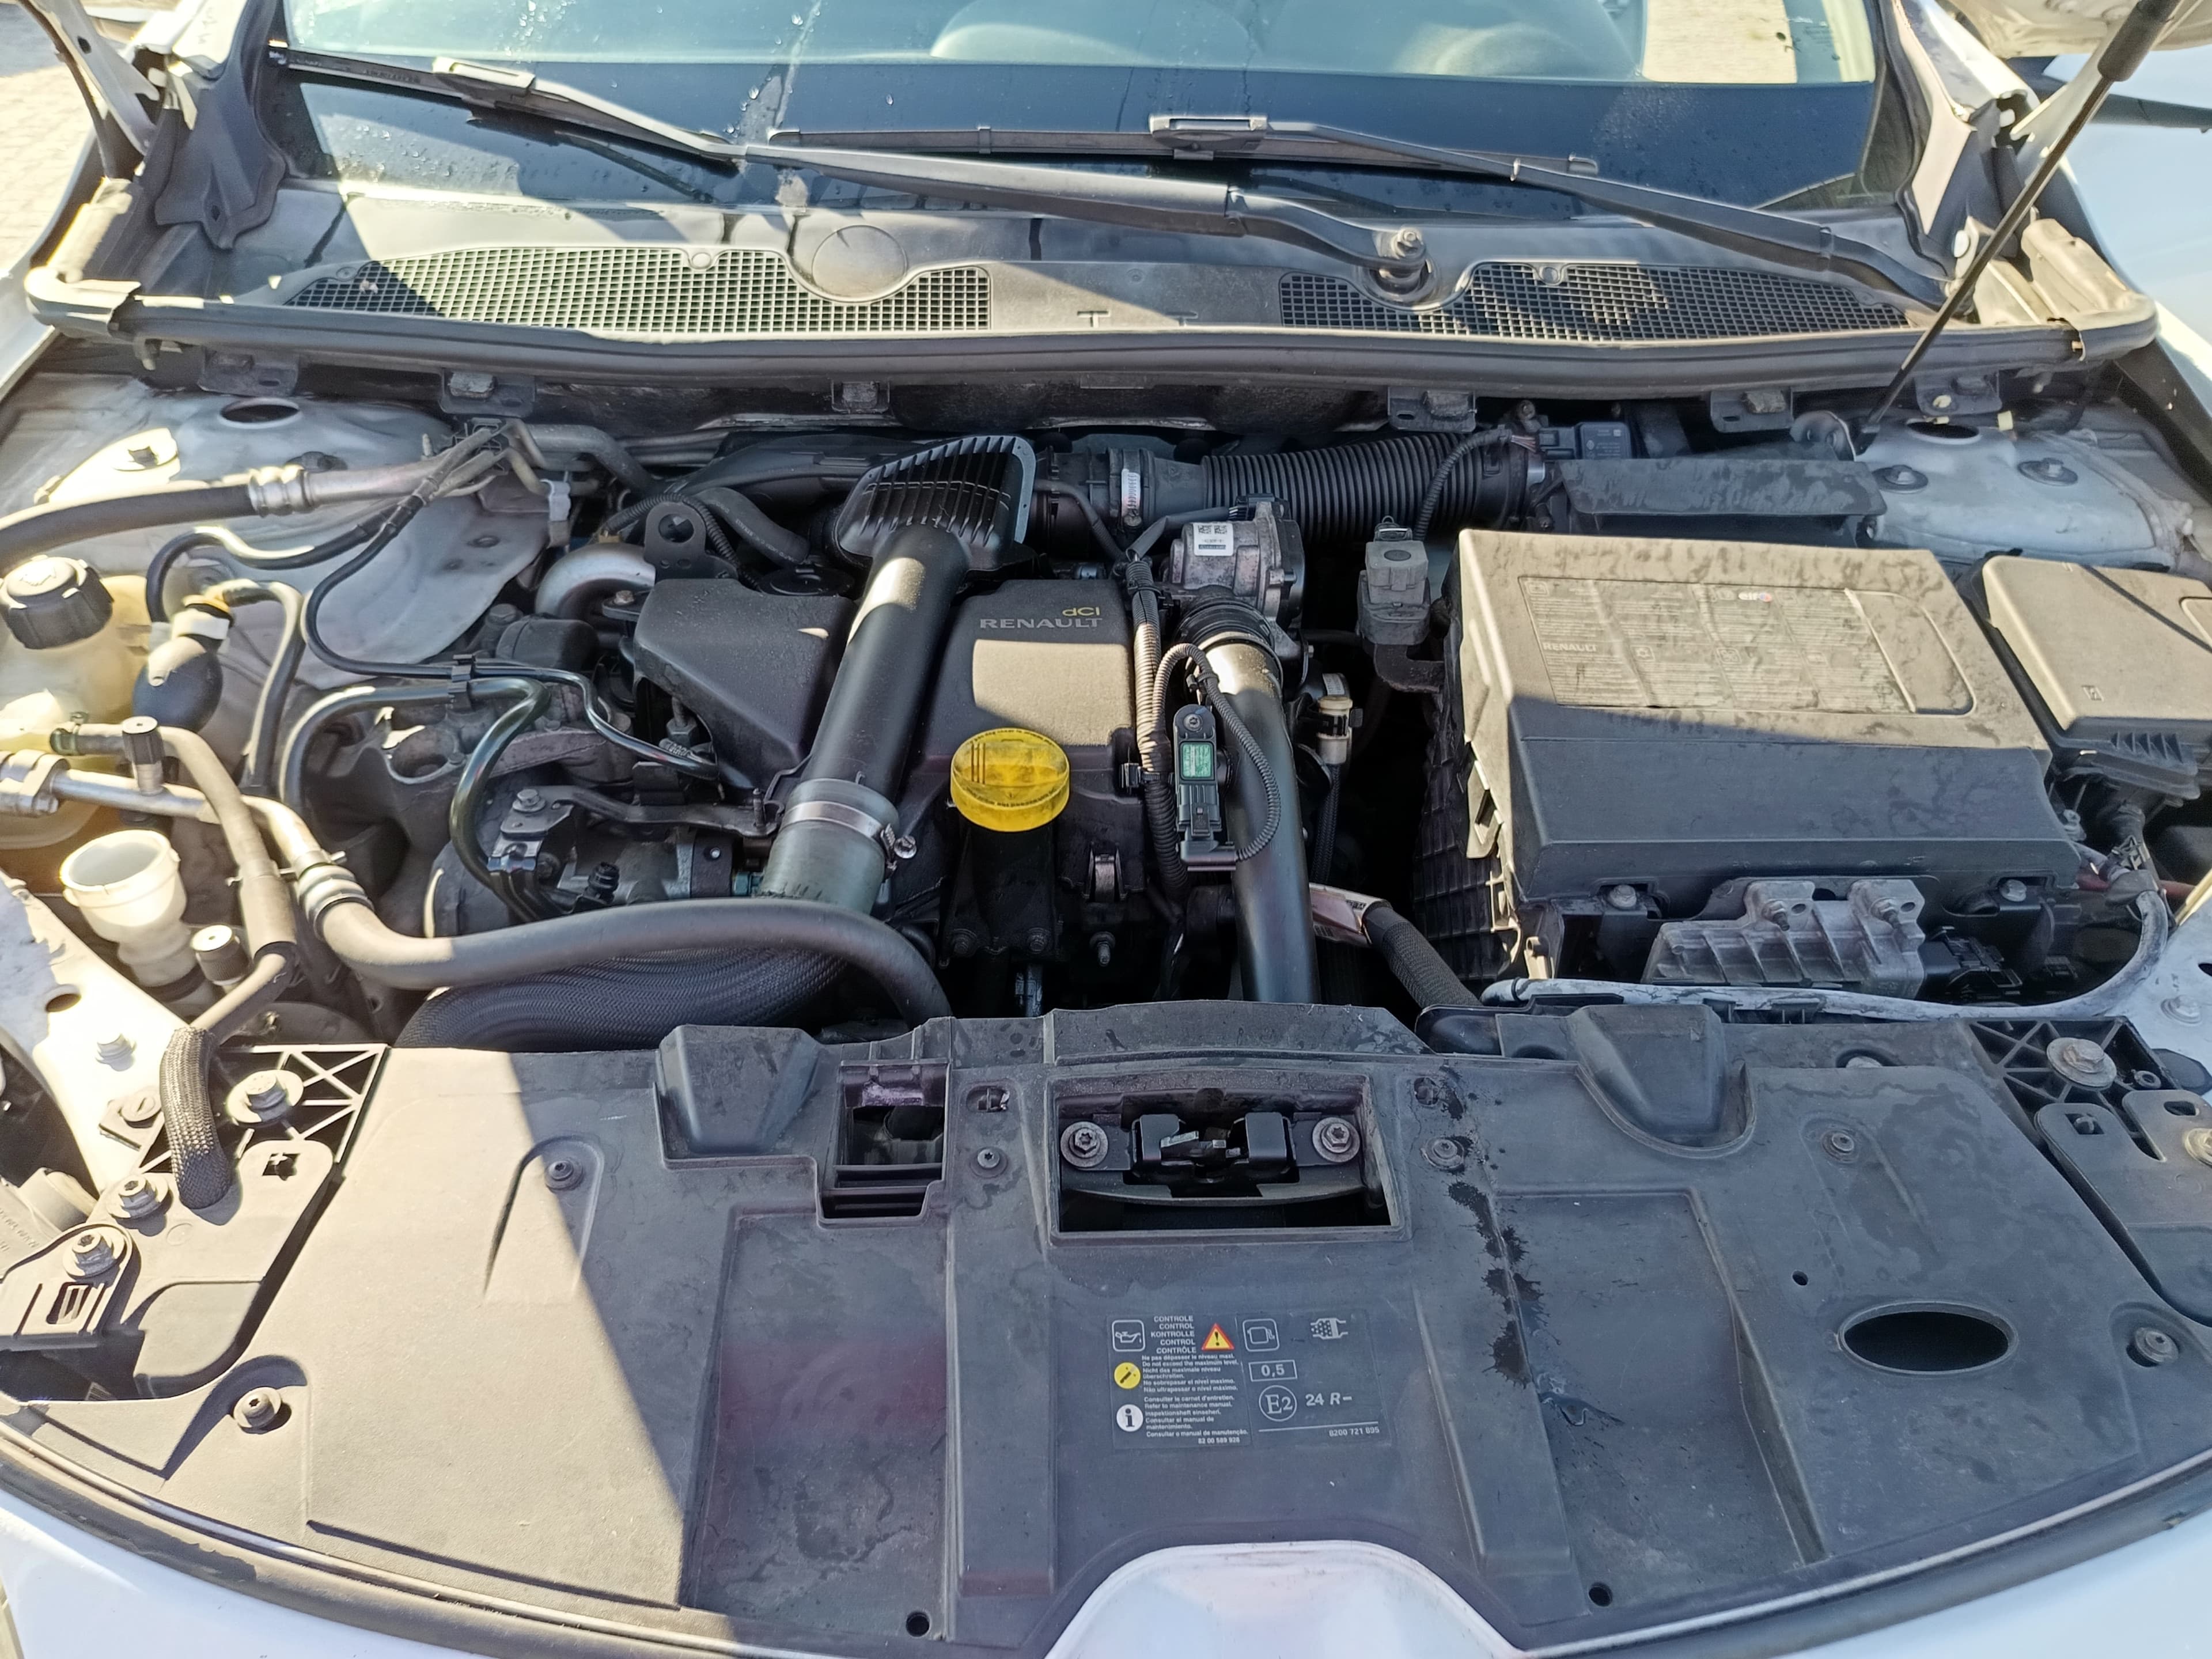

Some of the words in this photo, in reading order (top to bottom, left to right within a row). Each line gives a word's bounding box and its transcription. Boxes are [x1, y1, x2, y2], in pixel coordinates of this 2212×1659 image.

[980, 618, 1103, 628] RENAULT
[1542, 643, 1598, 652] RENAULT
[1261, 1363, 1285, 1377] 0,5
[1264, 1394, 1293, 1414] E2
[1305, 1393, 1325, 1406] 24
[1350, 1427, 1363, 1435] 721
